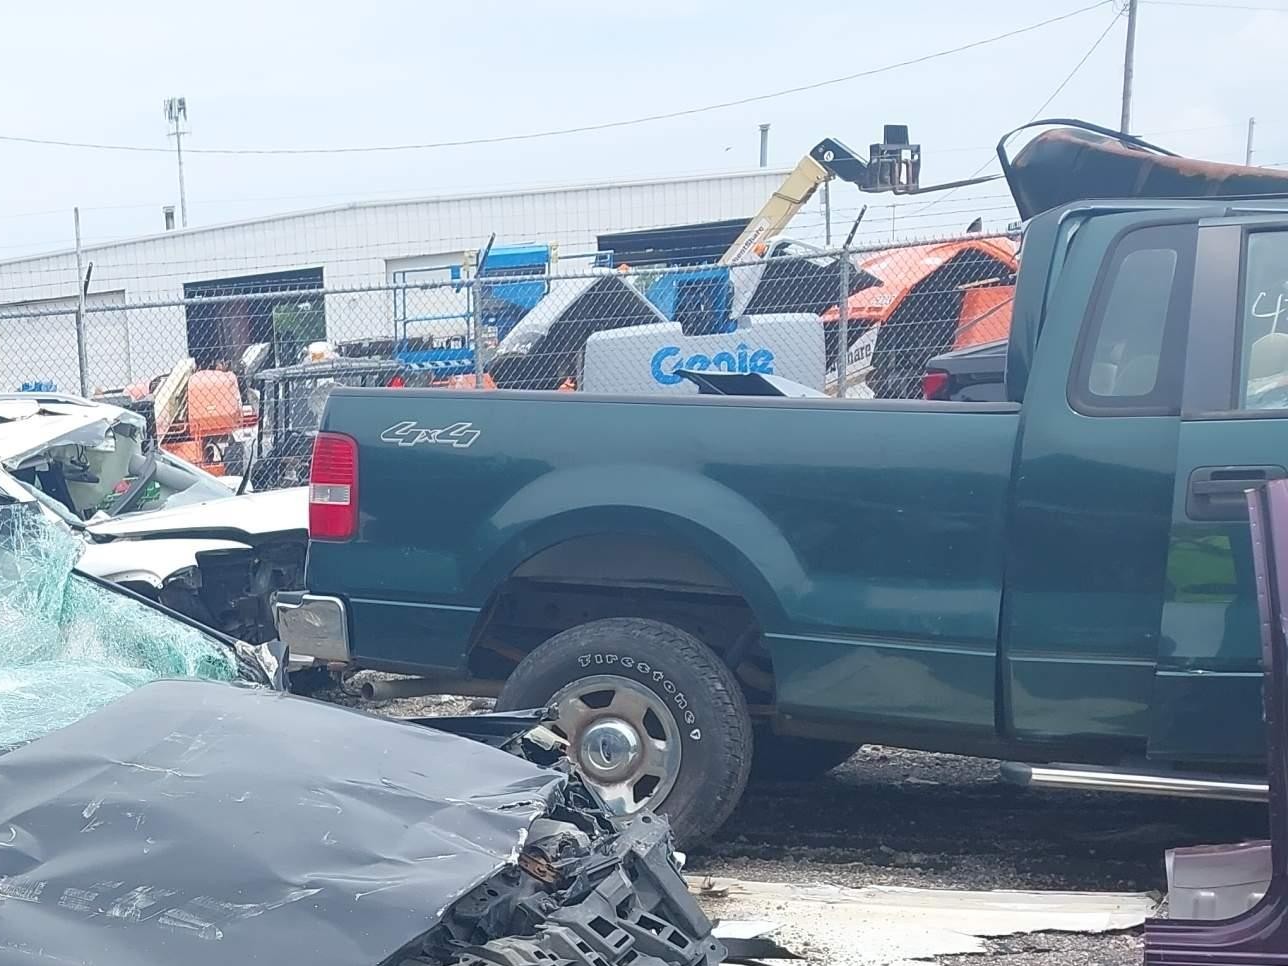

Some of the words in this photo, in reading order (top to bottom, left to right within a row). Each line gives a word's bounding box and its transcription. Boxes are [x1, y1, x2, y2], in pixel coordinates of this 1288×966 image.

[651, 343, 775, 385] Genie
[380, 421, 481, 447] 4x4
[578, 654, 695, 726] Firestone
